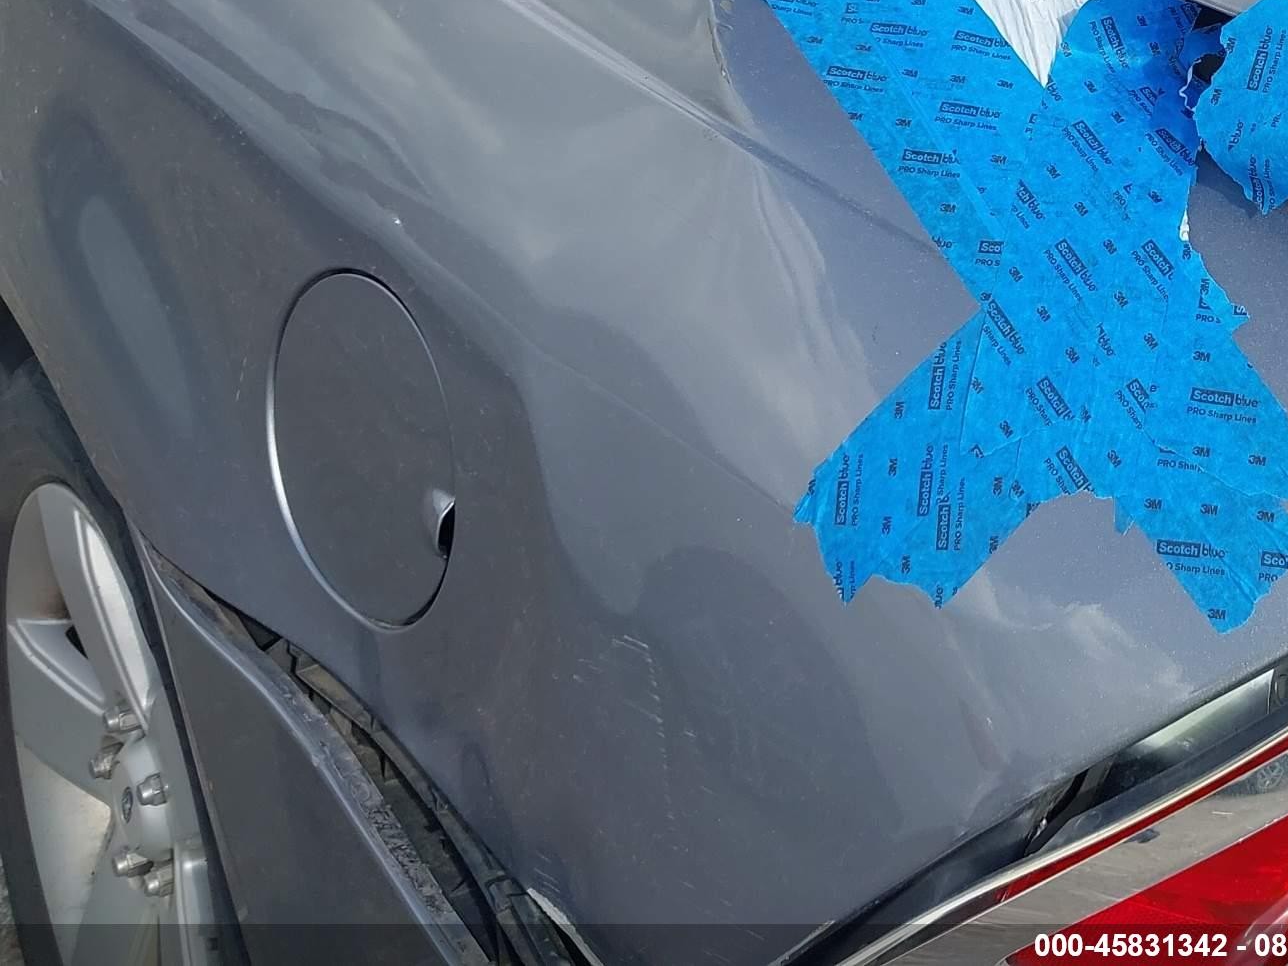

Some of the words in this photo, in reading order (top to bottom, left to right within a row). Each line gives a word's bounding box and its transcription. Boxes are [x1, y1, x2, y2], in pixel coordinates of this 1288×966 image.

[1193, 351, 1210, 362] 3M
[1187, 406, 1206, 415] PRO
[1208, 410, 1233, 421] Sharp
[1235, 412, 1256, 423] Lines
[1192, 446, 1210, 457] 3M
[1248, 455, 1266, 466] 3M
[1056, 475, 1071, 495] Shar
[1144, 498, 1161, 509] 3M
[1201, 504, 1217, 515] 3M
[1257, 510, 1274, 522] 3M
[1175, 563, 1200, 575] Sharp
[1202, 565, 1225, 576] Lines
[1259, 573, 1278, 582] PRO
[1208, 608, 1226, 619] 3M
